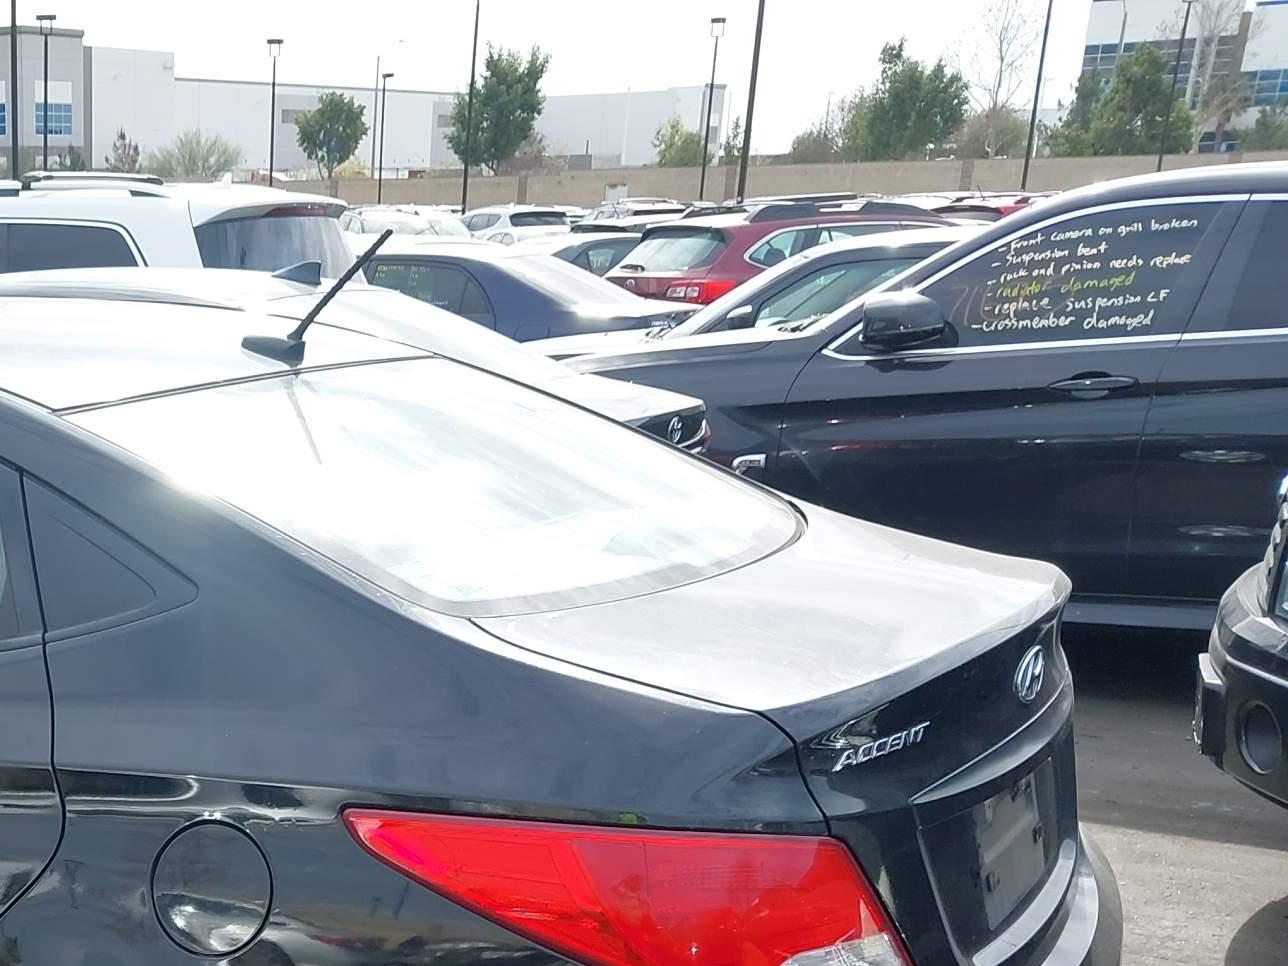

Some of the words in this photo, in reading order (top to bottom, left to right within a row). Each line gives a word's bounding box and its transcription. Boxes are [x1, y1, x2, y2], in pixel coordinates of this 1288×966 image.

[1050, 228, 1092, 241] camera
[1098, 226, 1113, 236] on
[1117, 222, 1142, 236] grill
[1151, 219, 1198, 231] broken
[1077, 241, 1108, 256] bent
[1032, 262, 1055, 276] and
[1061, 260, 1101, 275] pinion
[1110, 255, 1144, 268] needs
[1061, 271, 1136, 293] damaged
[1083, 308, 1154, 331] damaged
[831, 720, 931, 773] ACCENT
